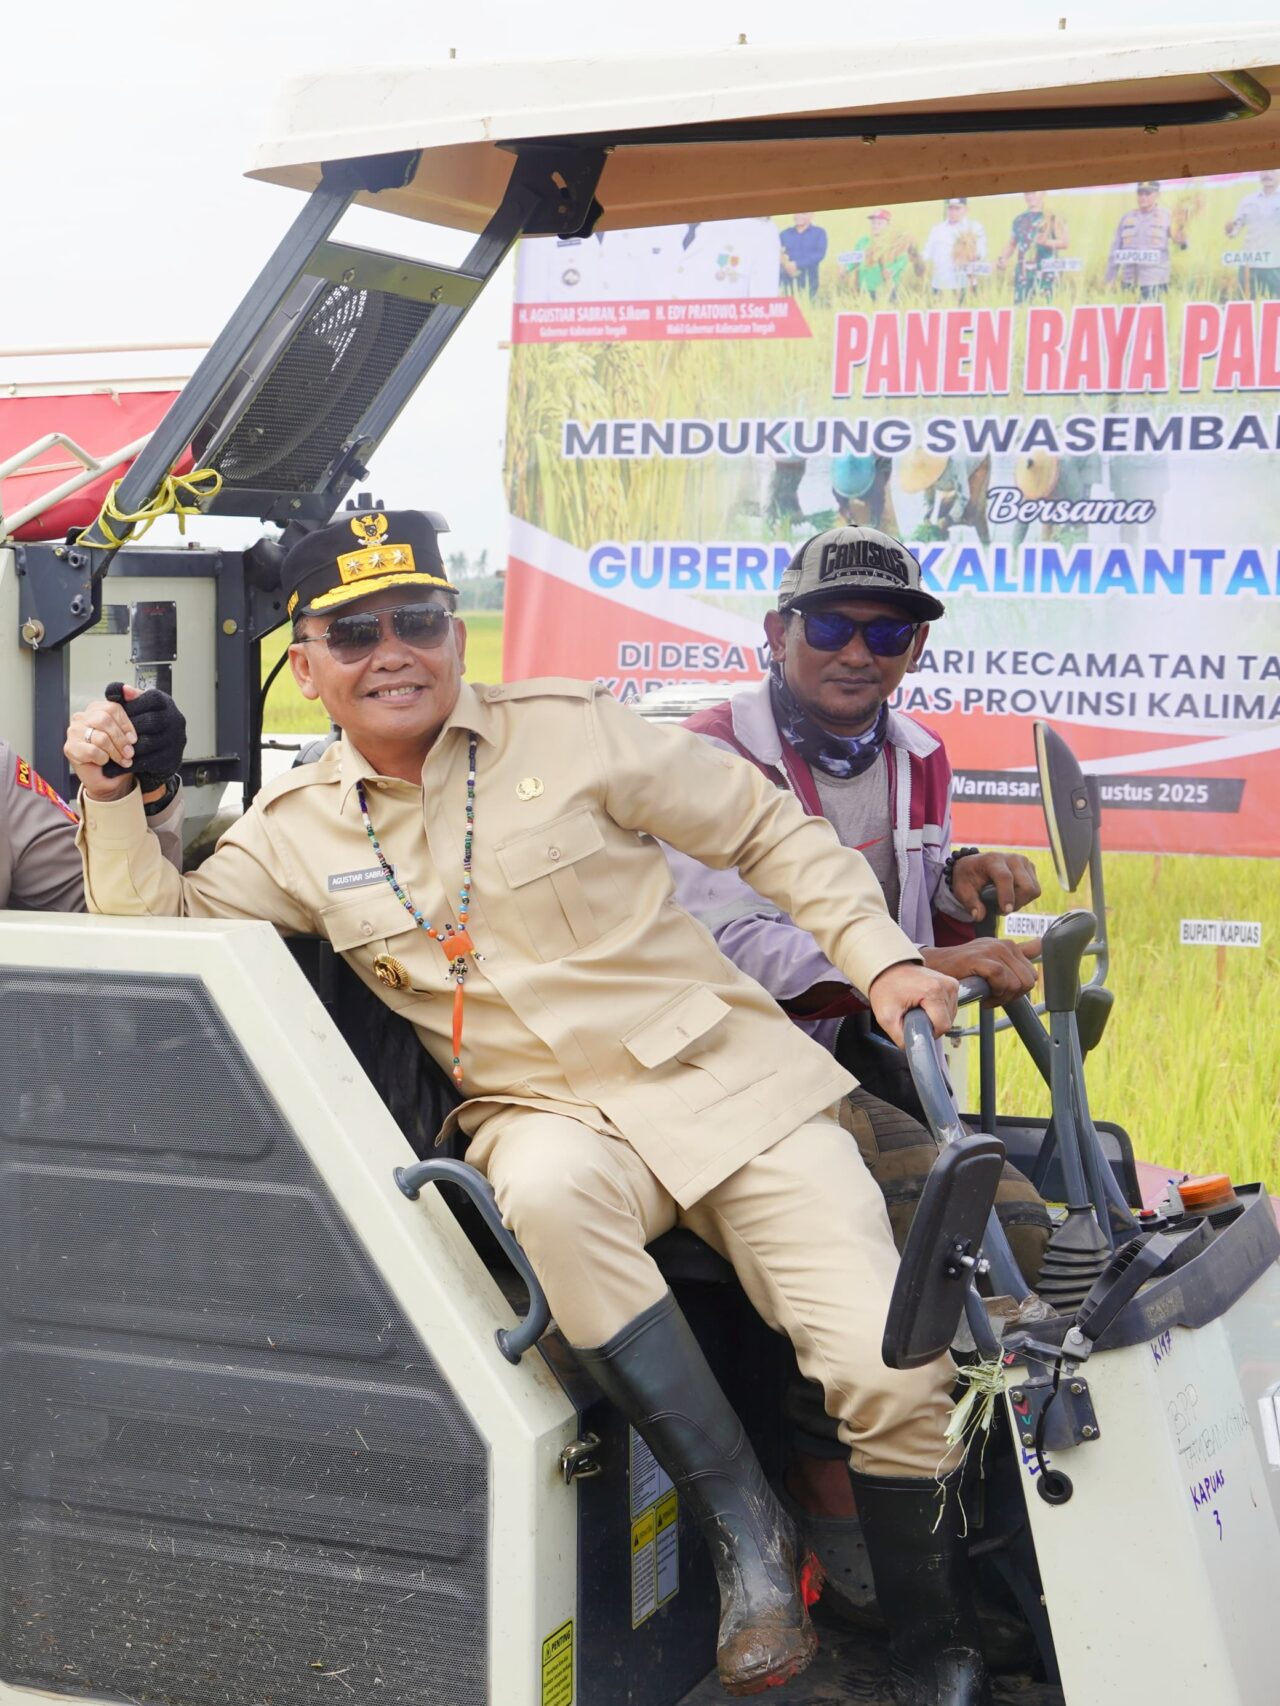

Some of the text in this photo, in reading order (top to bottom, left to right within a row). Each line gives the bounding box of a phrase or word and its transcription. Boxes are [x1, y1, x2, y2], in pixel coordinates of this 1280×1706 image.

[1115, 251, 1160, 263] KAPOLRES
[1224, 252, 1271, 264] CAMAT
[668, 304, 687, 320] EDY
[834, 311, 1012, 396] PANEN
[1025, 305, 1169, 394] RAYA
[565, 415, 1280, 456] MENDUKUNG SWASEMBA
[987, 487, 1156, 524] Bersama
[588, 545, 1280, 596] GUBER KALIMANTA
[621, 644, 650, 668] DI
[660, 644, 745, 670] DESA
[986, 650, 1225, 679] KECAMATAN
[964, 688, 1136, 717] PROVINSI
[951, 775, 1208, 803] Warnasar ustus 2025
[332, 869, 386, 886] AGUSTIAR SABRA
[1007, 916, 1045, 935] GUBERNUR
[1182, 923, 1259, 945] BUPATI KAPUAS
[1190, 1469, 1225, 1511] KAPUAS
